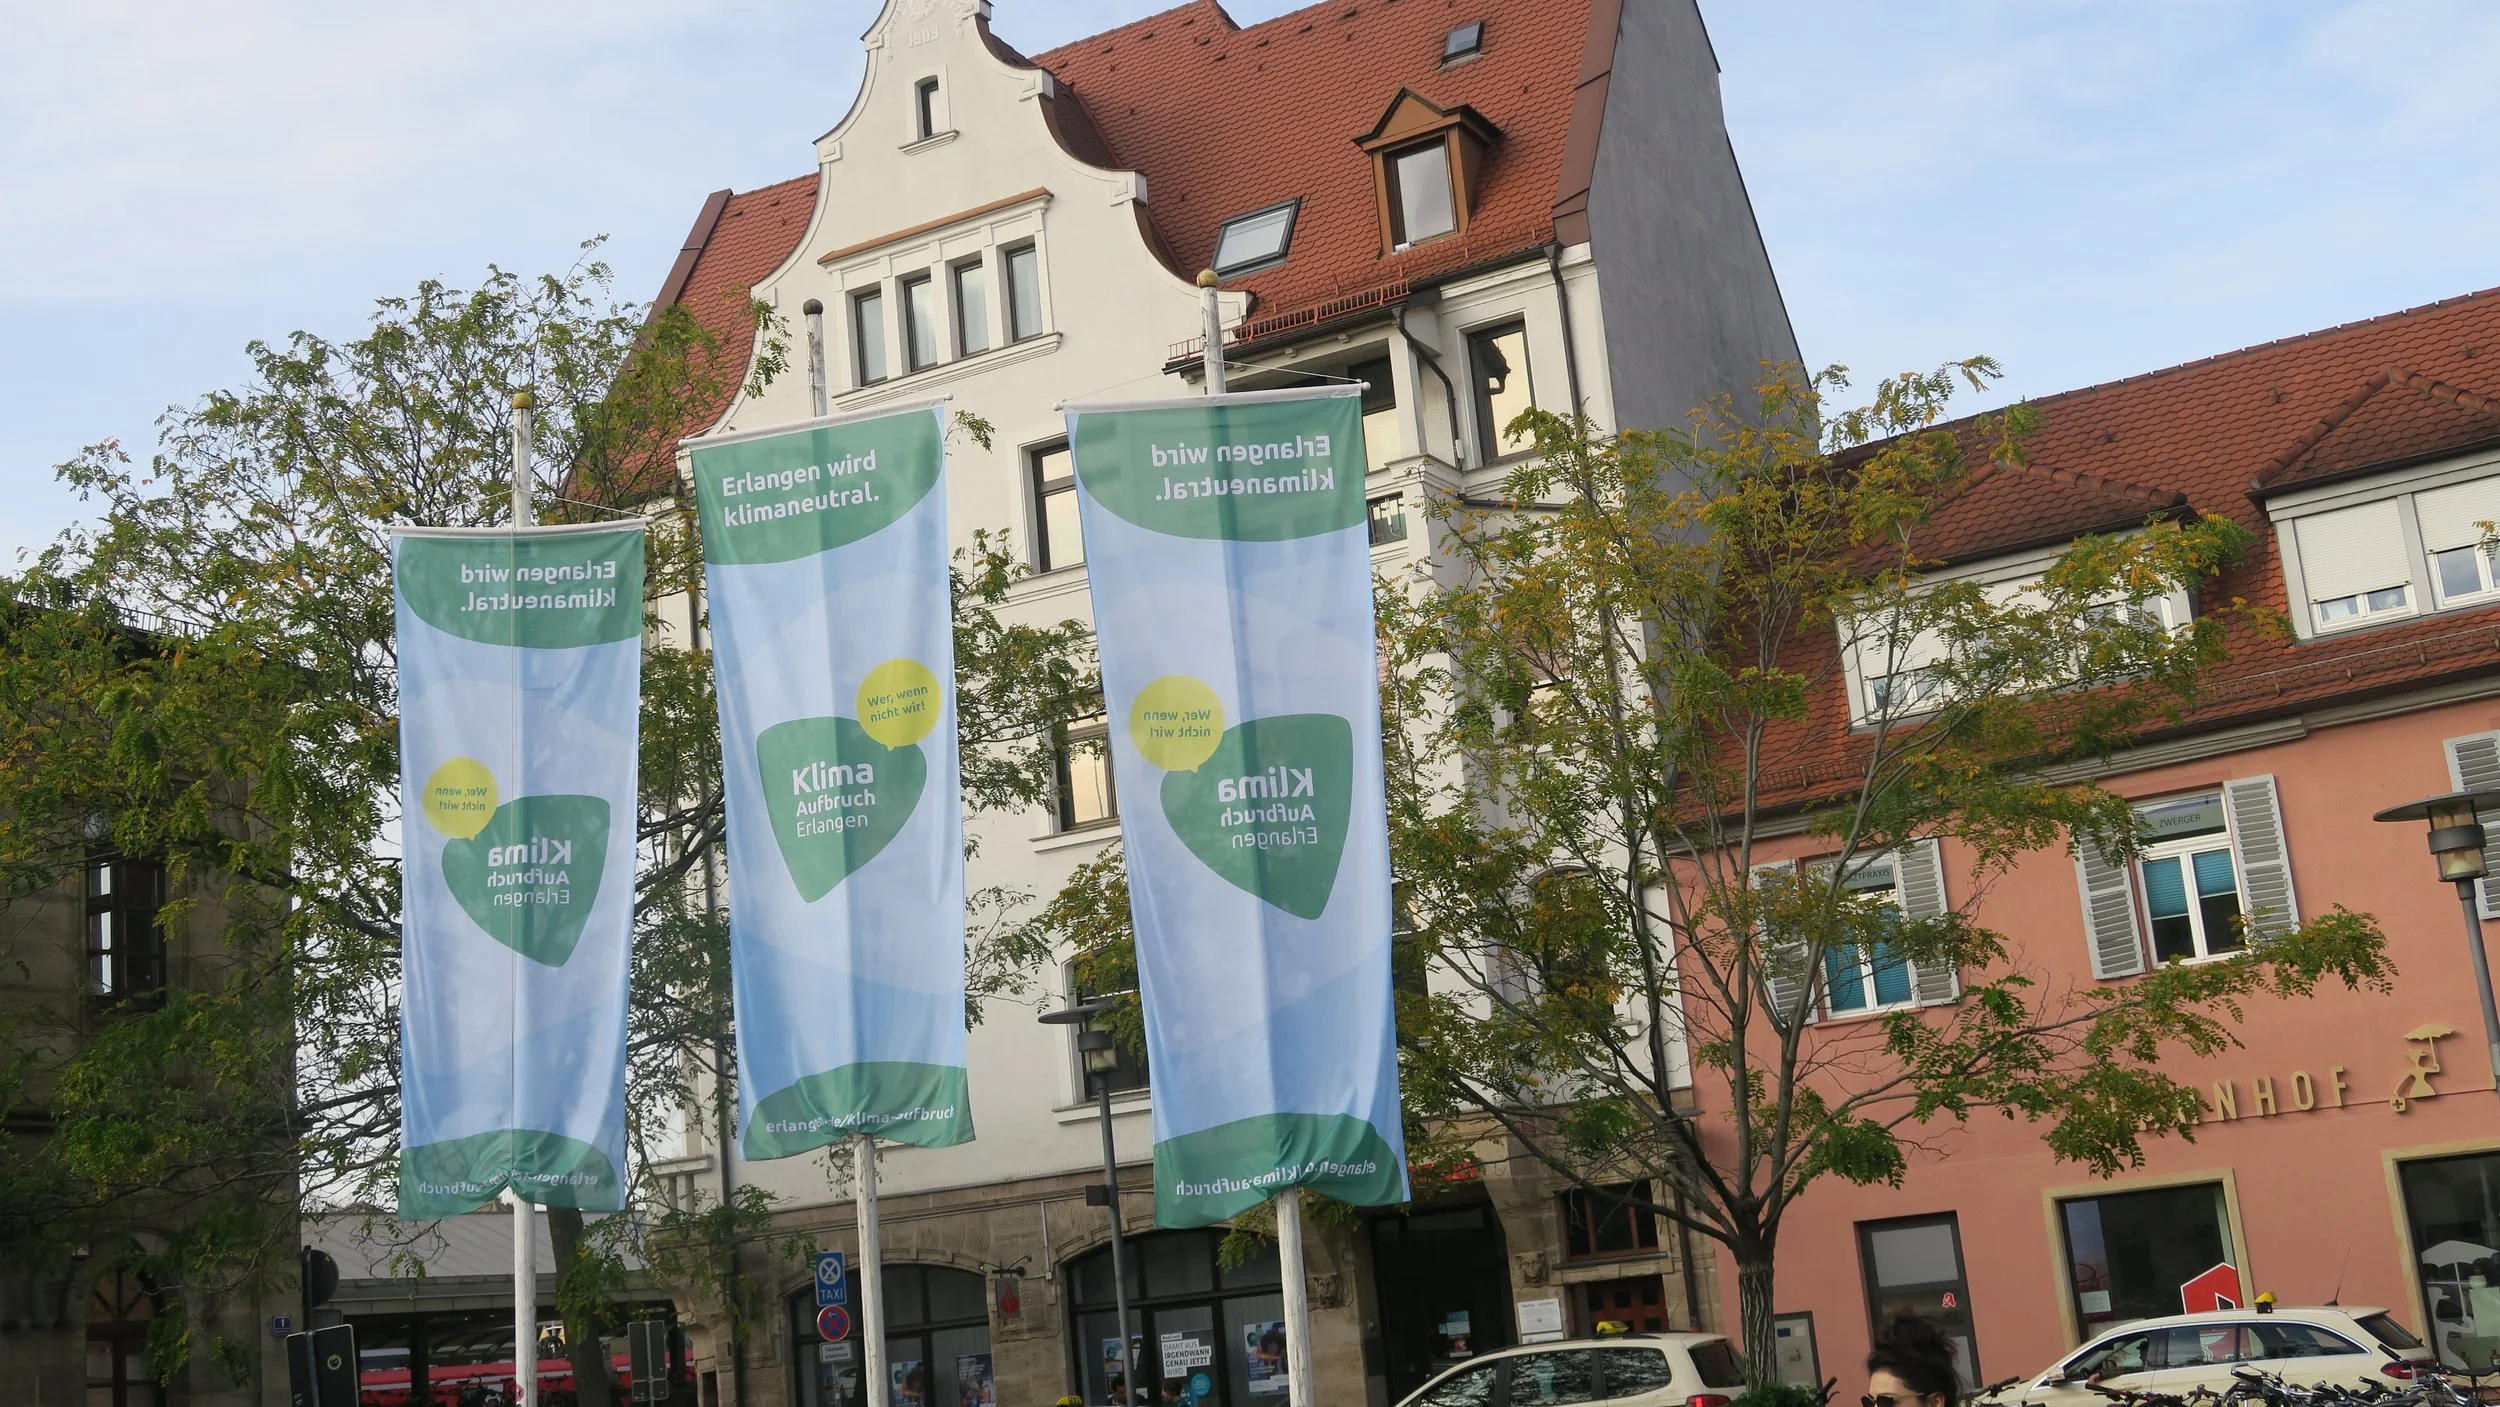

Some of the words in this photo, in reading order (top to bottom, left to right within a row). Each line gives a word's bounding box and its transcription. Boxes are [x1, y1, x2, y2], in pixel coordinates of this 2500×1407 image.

[909, 26, 938, 48] 1909
[721, 464, 821, 497] Erlangen
[826, 449, 877, 478] wird
[723, 481, 880, 528] klimaneutral.
[866, 693, 894, 708] Wer,
[895, 685, 929, 700] wenn
[870, 706, 900, 723] nicht
[901, 700, 926, 715] wir!
[792, 760, 875, 796] Klima
[796, 789, 876, 817] Aufbruch
[796, 814, 869, 838] Erlangen
[2159, 813, 2202, 828] ZWERGER
[820, 1287, 843, 1301] TAXI
[1164, 1348, 1210, 1359] IRGENDWANN
[1185, 1341, 1198, 1350] AUS
[1165, 1359, 1188, 1368] GENAU
[1190, 1356, 1208, 1365] JETZT
